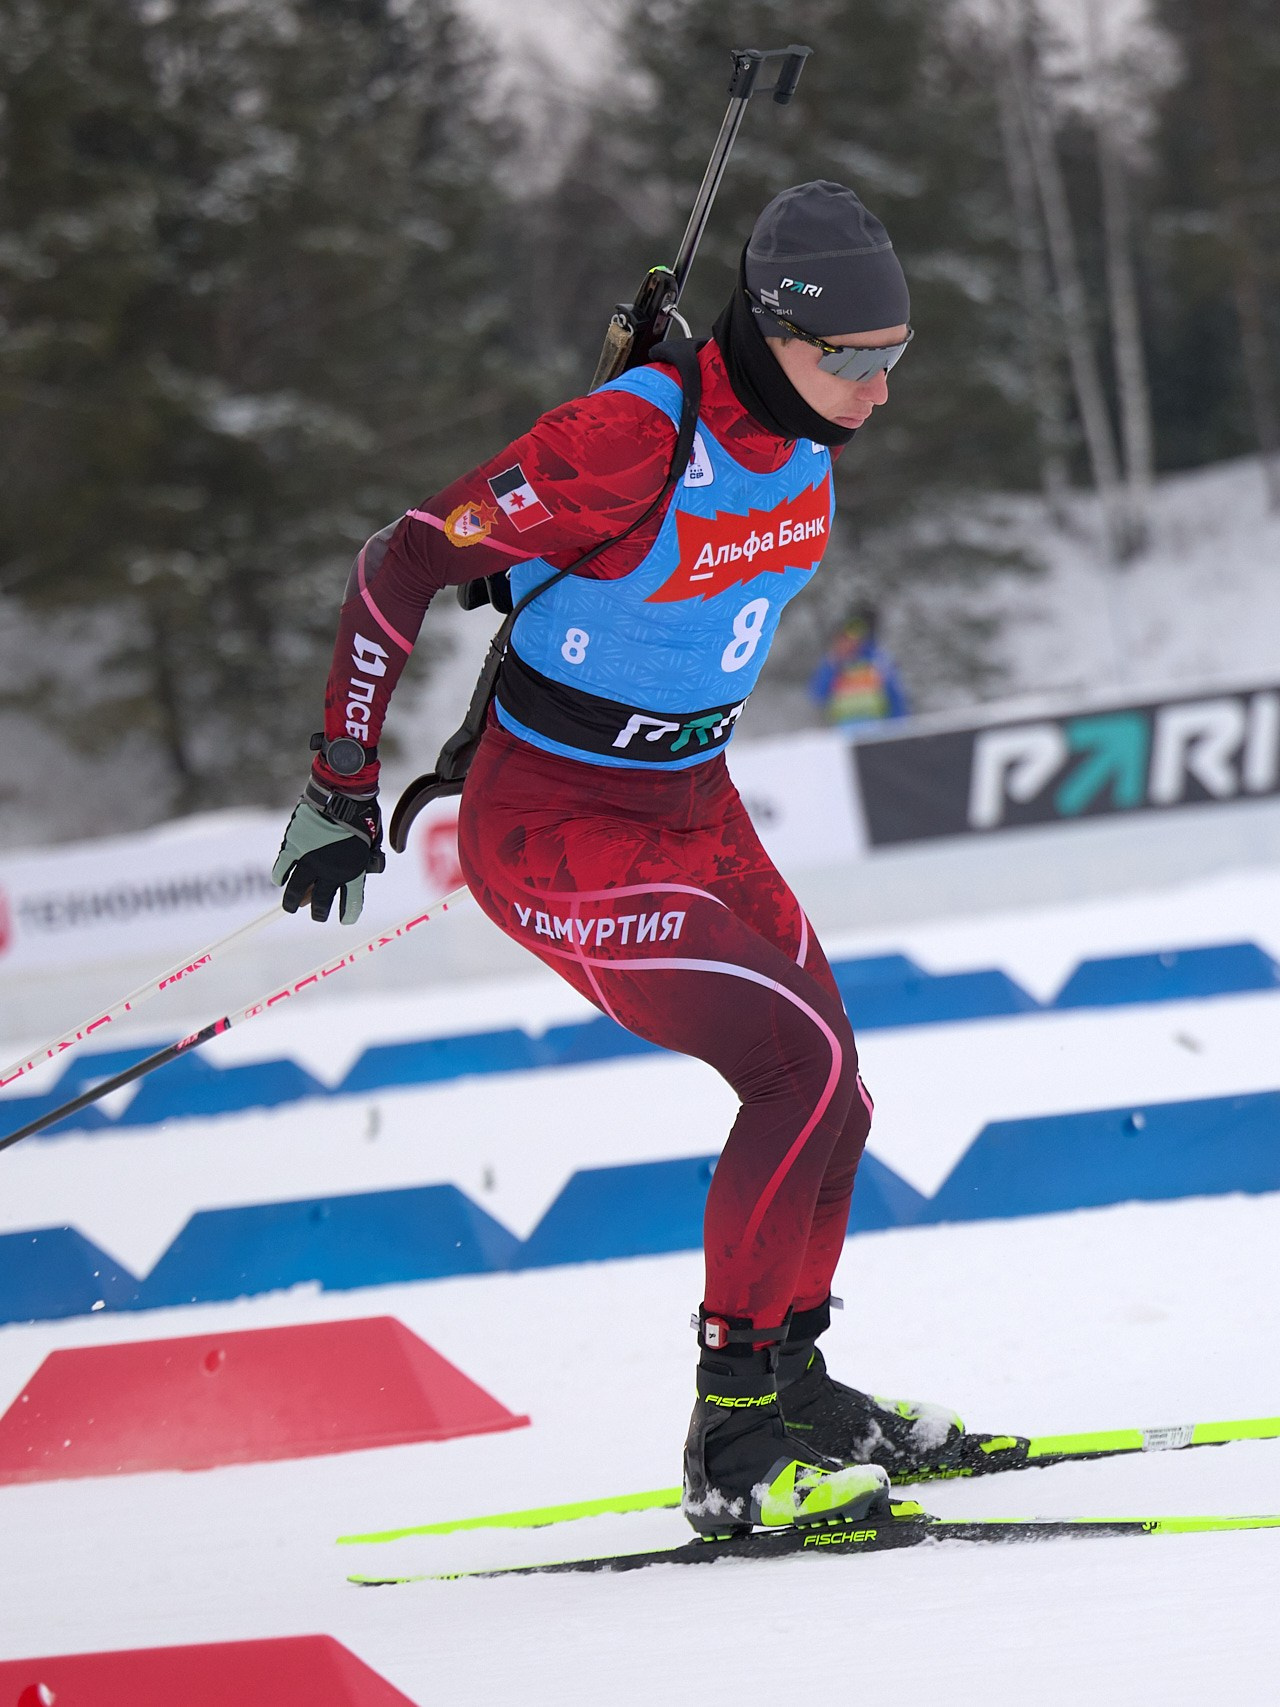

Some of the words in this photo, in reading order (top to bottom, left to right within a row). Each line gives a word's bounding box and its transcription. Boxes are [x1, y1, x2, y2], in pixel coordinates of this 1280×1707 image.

[780, 278, 823, 298] PARI
[690, 530, 774, 573] Альфа
[778, 515, 826, 547] Банк
[561, 628, 590, 665] 8
[720, 598, 770, 673] 8
[18, 863, 278, 934] ТЕХНОНИКОЛ
[513, 902, 686, 946] УДМУРТИЯ
[705, 1391, 777, 1408] FISCHER
[803, 1529, 877, 1547] FISCHER
